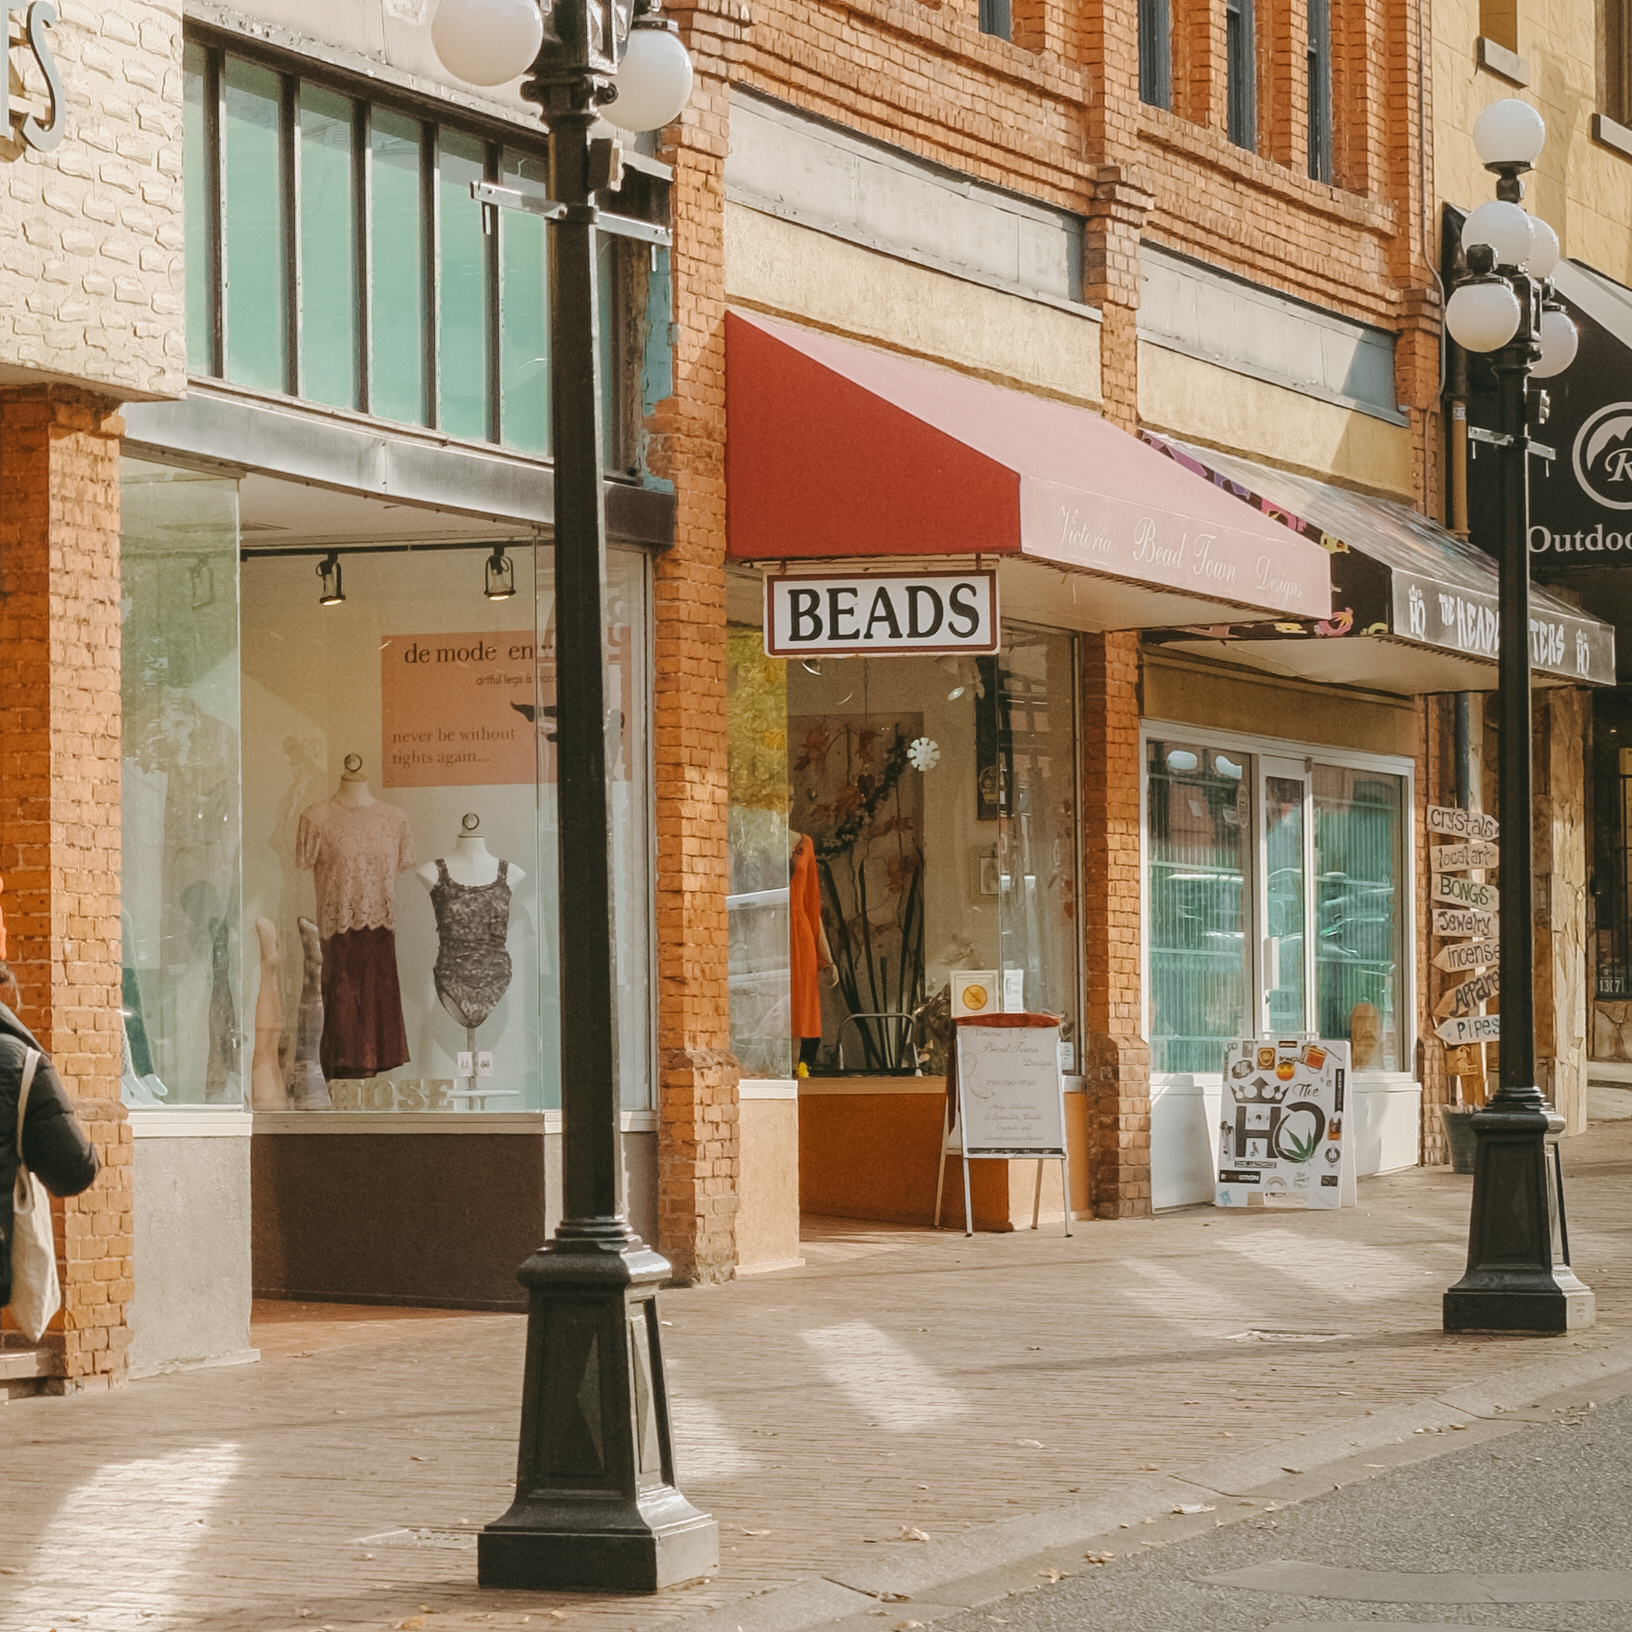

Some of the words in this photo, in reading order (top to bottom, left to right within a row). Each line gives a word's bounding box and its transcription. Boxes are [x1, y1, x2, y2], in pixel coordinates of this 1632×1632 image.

[1059, 504, 1113, 555] Victoria
[1132, 516, 1188, 570] Bead
[1192, 532, 1238, 584] Town
[1255, 555, 1303, 606] Designs
[787, 582, 980, 642] BEADS
[404, 643, 430, 664] de
[436, 641, 497, 662] mode
[504, 673, 523, 687] legs
[392, 731, 433, 744] never
[438, 727, 455, 742] be
[460, 727, 516, 741] without
[392, 750, 433, 769] tights
[1438, 846, 1469, 869] local
[1471, 845, 1491, 865] art
[1439, 874, 1489, 906] BONGS
[1437, 911, 1491, 936] Jewelry
[1293, 1083, 1319, 1098] The
